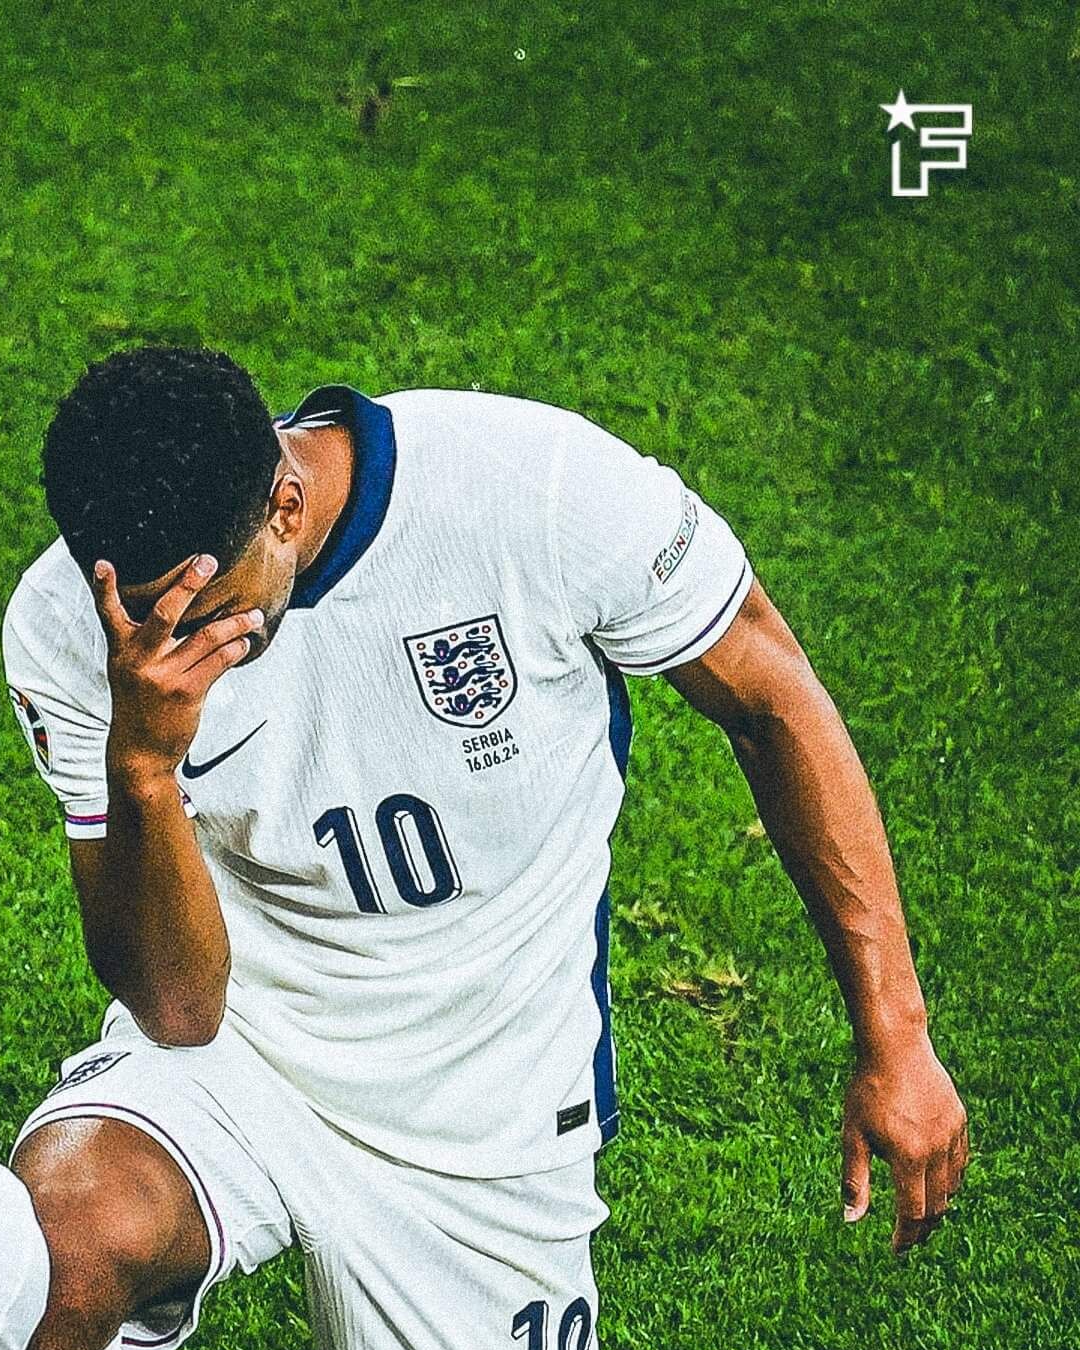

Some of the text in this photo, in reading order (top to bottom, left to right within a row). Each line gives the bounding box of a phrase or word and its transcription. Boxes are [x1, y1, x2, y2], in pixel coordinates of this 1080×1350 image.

[462, 727, 513, 753] SERBIA
[465, 743, 519, 772] 16.06.24
[312, 793, 463, 914] 10
